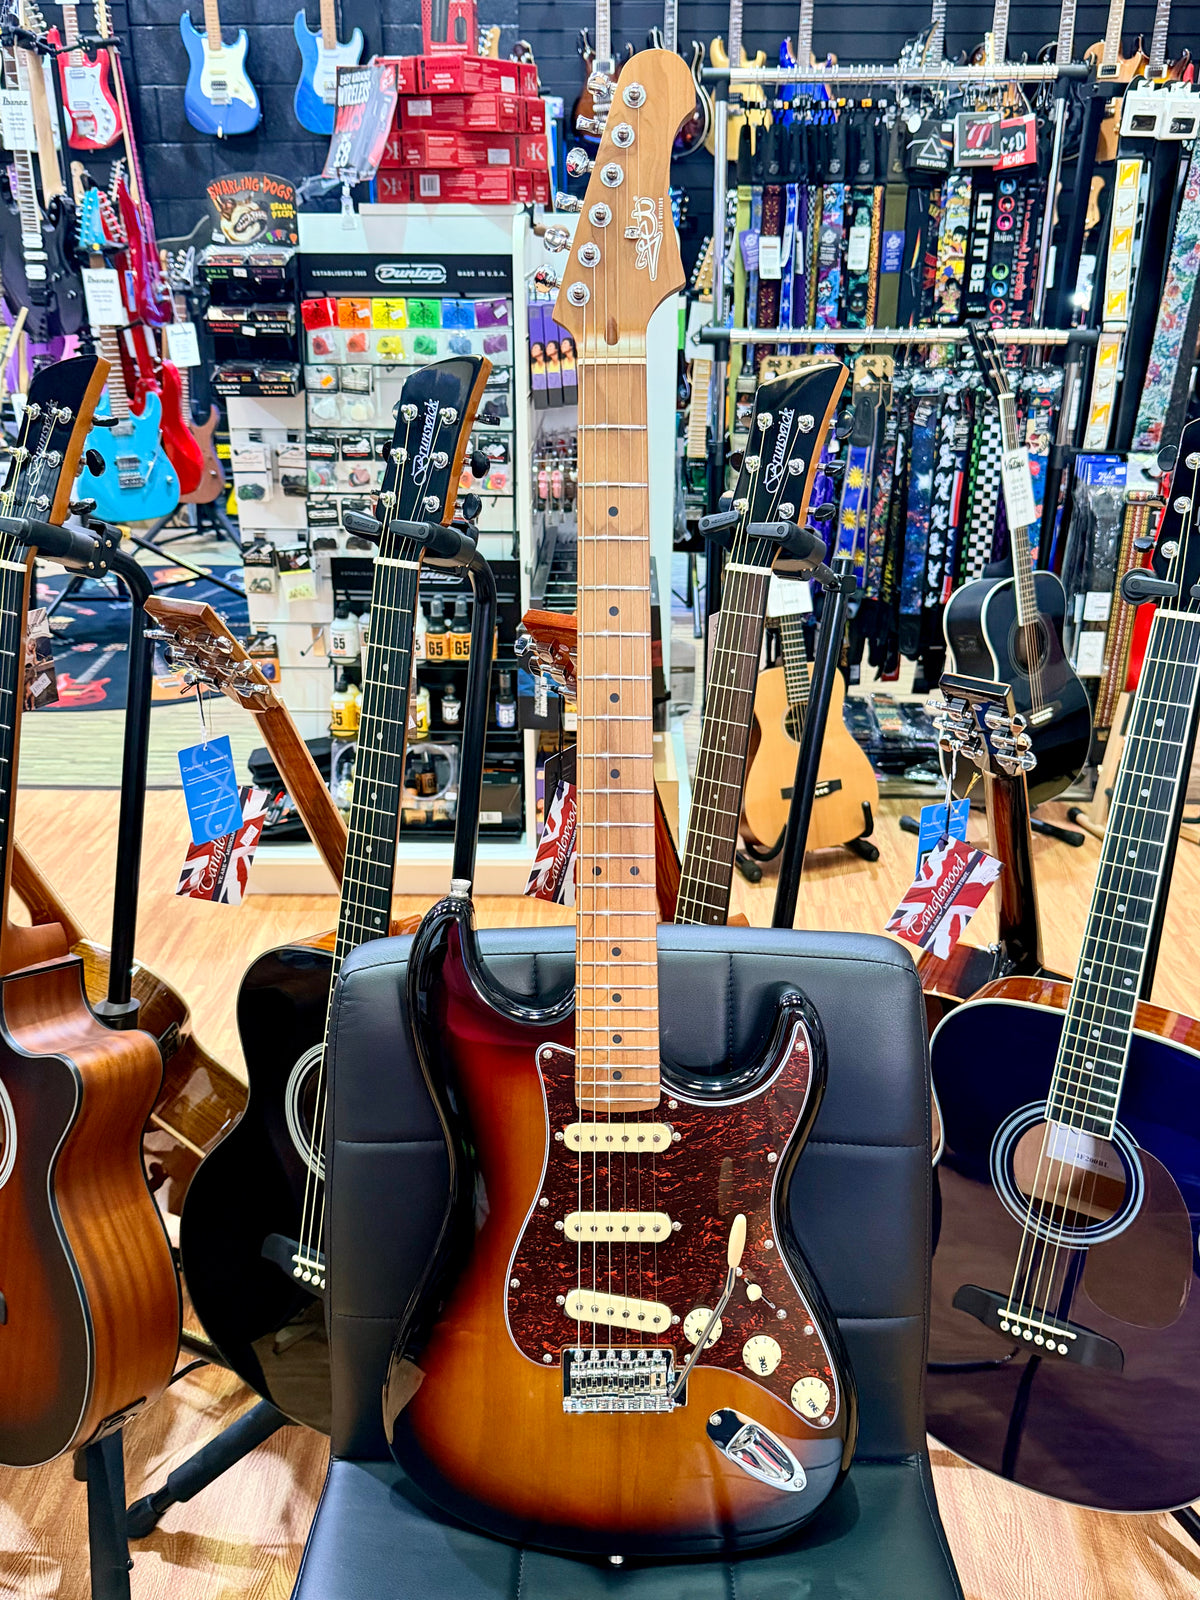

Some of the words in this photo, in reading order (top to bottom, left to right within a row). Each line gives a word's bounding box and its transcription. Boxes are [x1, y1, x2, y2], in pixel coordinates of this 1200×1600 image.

[338, 81, 371, 107] WIRELESS
[206, 176, 260, 200] SNARLING
[263, 175, 294, 201] DOGS
[976, 192, 994, 235] LET
[972, 237, 989, 262] IT
[380, 268, 443, 281] Dunlop
[457, 270, 474, 278] MADE
[478, 270, 485, 278] IN
[968, 263, 987, 293] BE
[411, 398, 440, 486] Brunswick
[763, 407, 795, 494] Brunswick
[333, 637, 346, 650] 65
[428, 642, 443, 656] 65
[455, 641, 470, 656] 65
[226, 832, 235, 856] MUSICIA
[541, 798, 577, 895] Tanglewood
[197, 835, 226, 894] Tangle
[906, 853, 966, 937] Tanglewood
[695, 1327, 715, 1346] VOME
[758, 1355, 768, 1373] TONE
[806, 1397, 821, 1414] TONE
